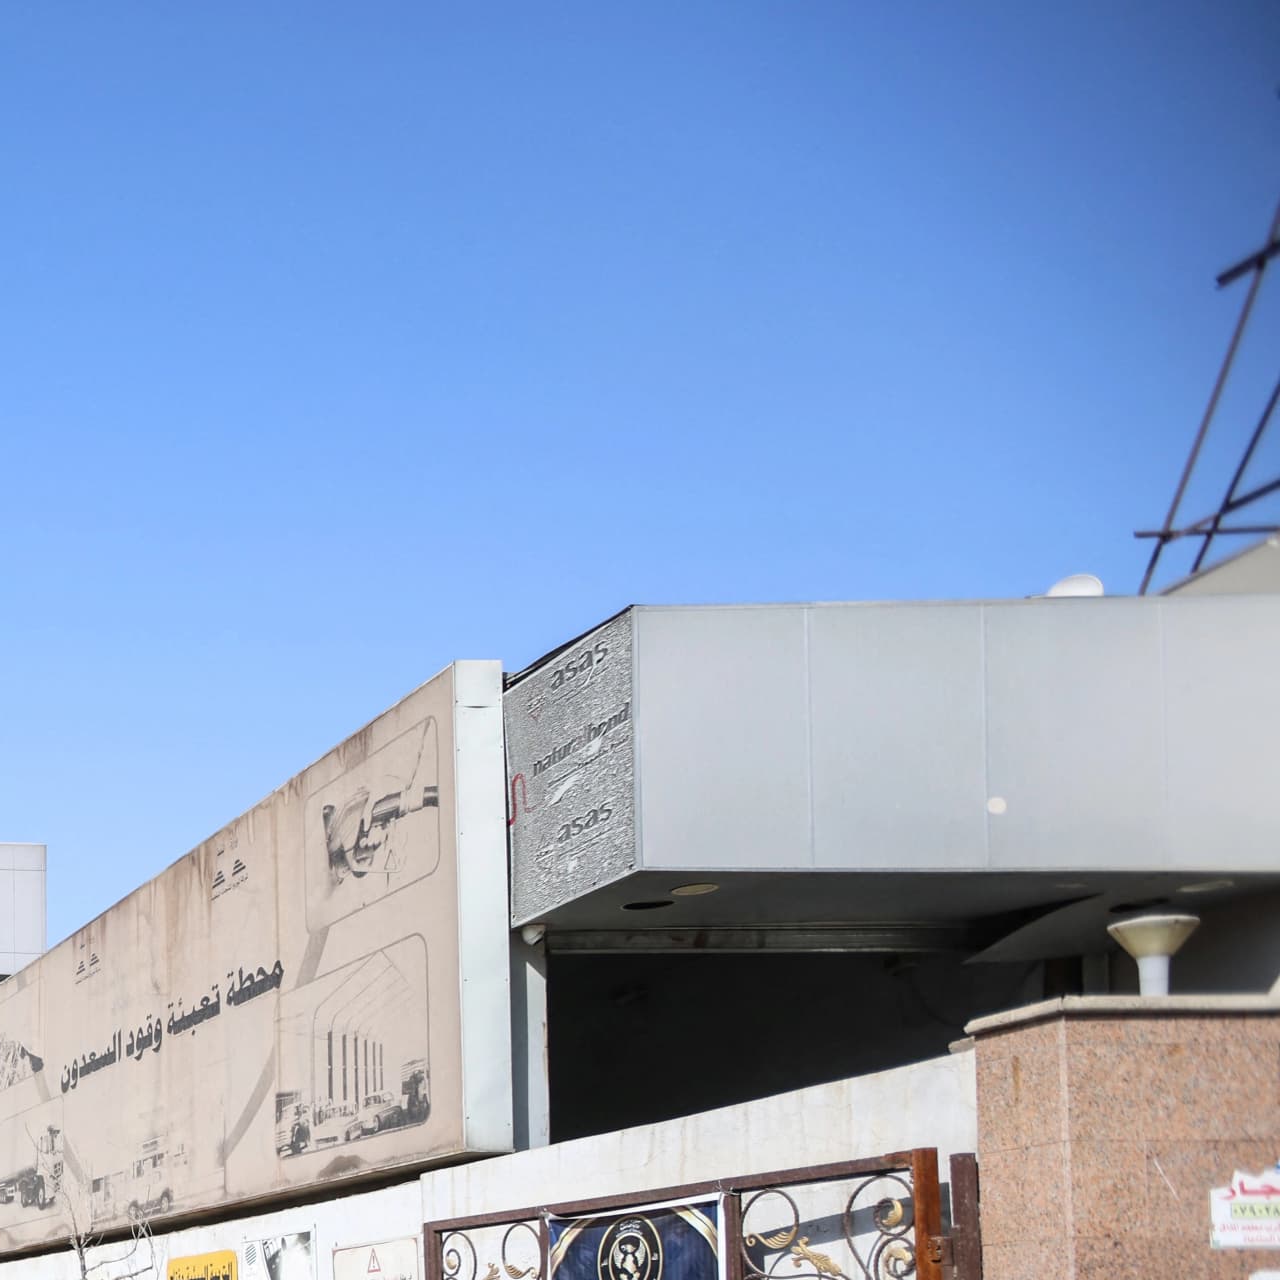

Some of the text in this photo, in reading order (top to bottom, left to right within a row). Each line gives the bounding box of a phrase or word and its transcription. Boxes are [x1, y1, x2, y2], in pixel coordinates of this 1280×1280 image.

[60, 959, 285, 1094] محطة تعبئة وقود السعدون
